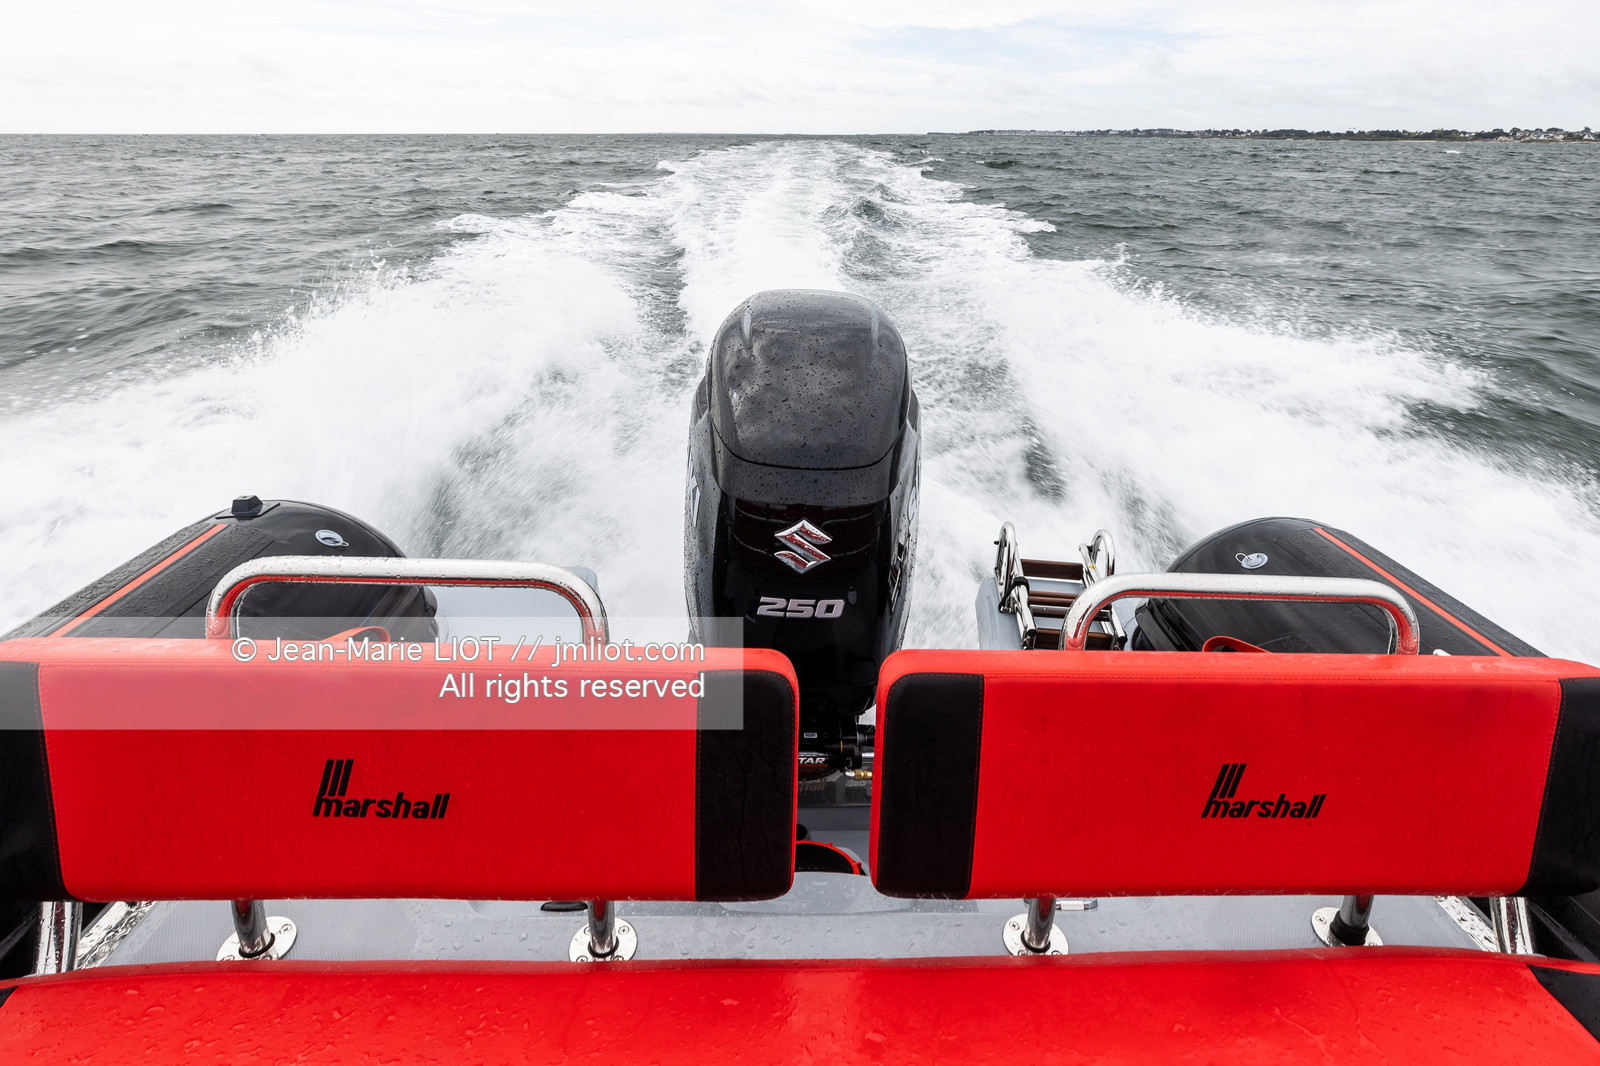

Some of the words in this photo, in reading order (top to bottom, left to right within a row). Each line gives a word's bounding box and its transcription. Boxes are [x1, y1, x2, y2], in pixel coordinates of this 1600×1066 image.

[756, 596, 846, 619] 250
[312, 792, 450, 819] marshall
[1201, 793, 1327, 818] marshall
